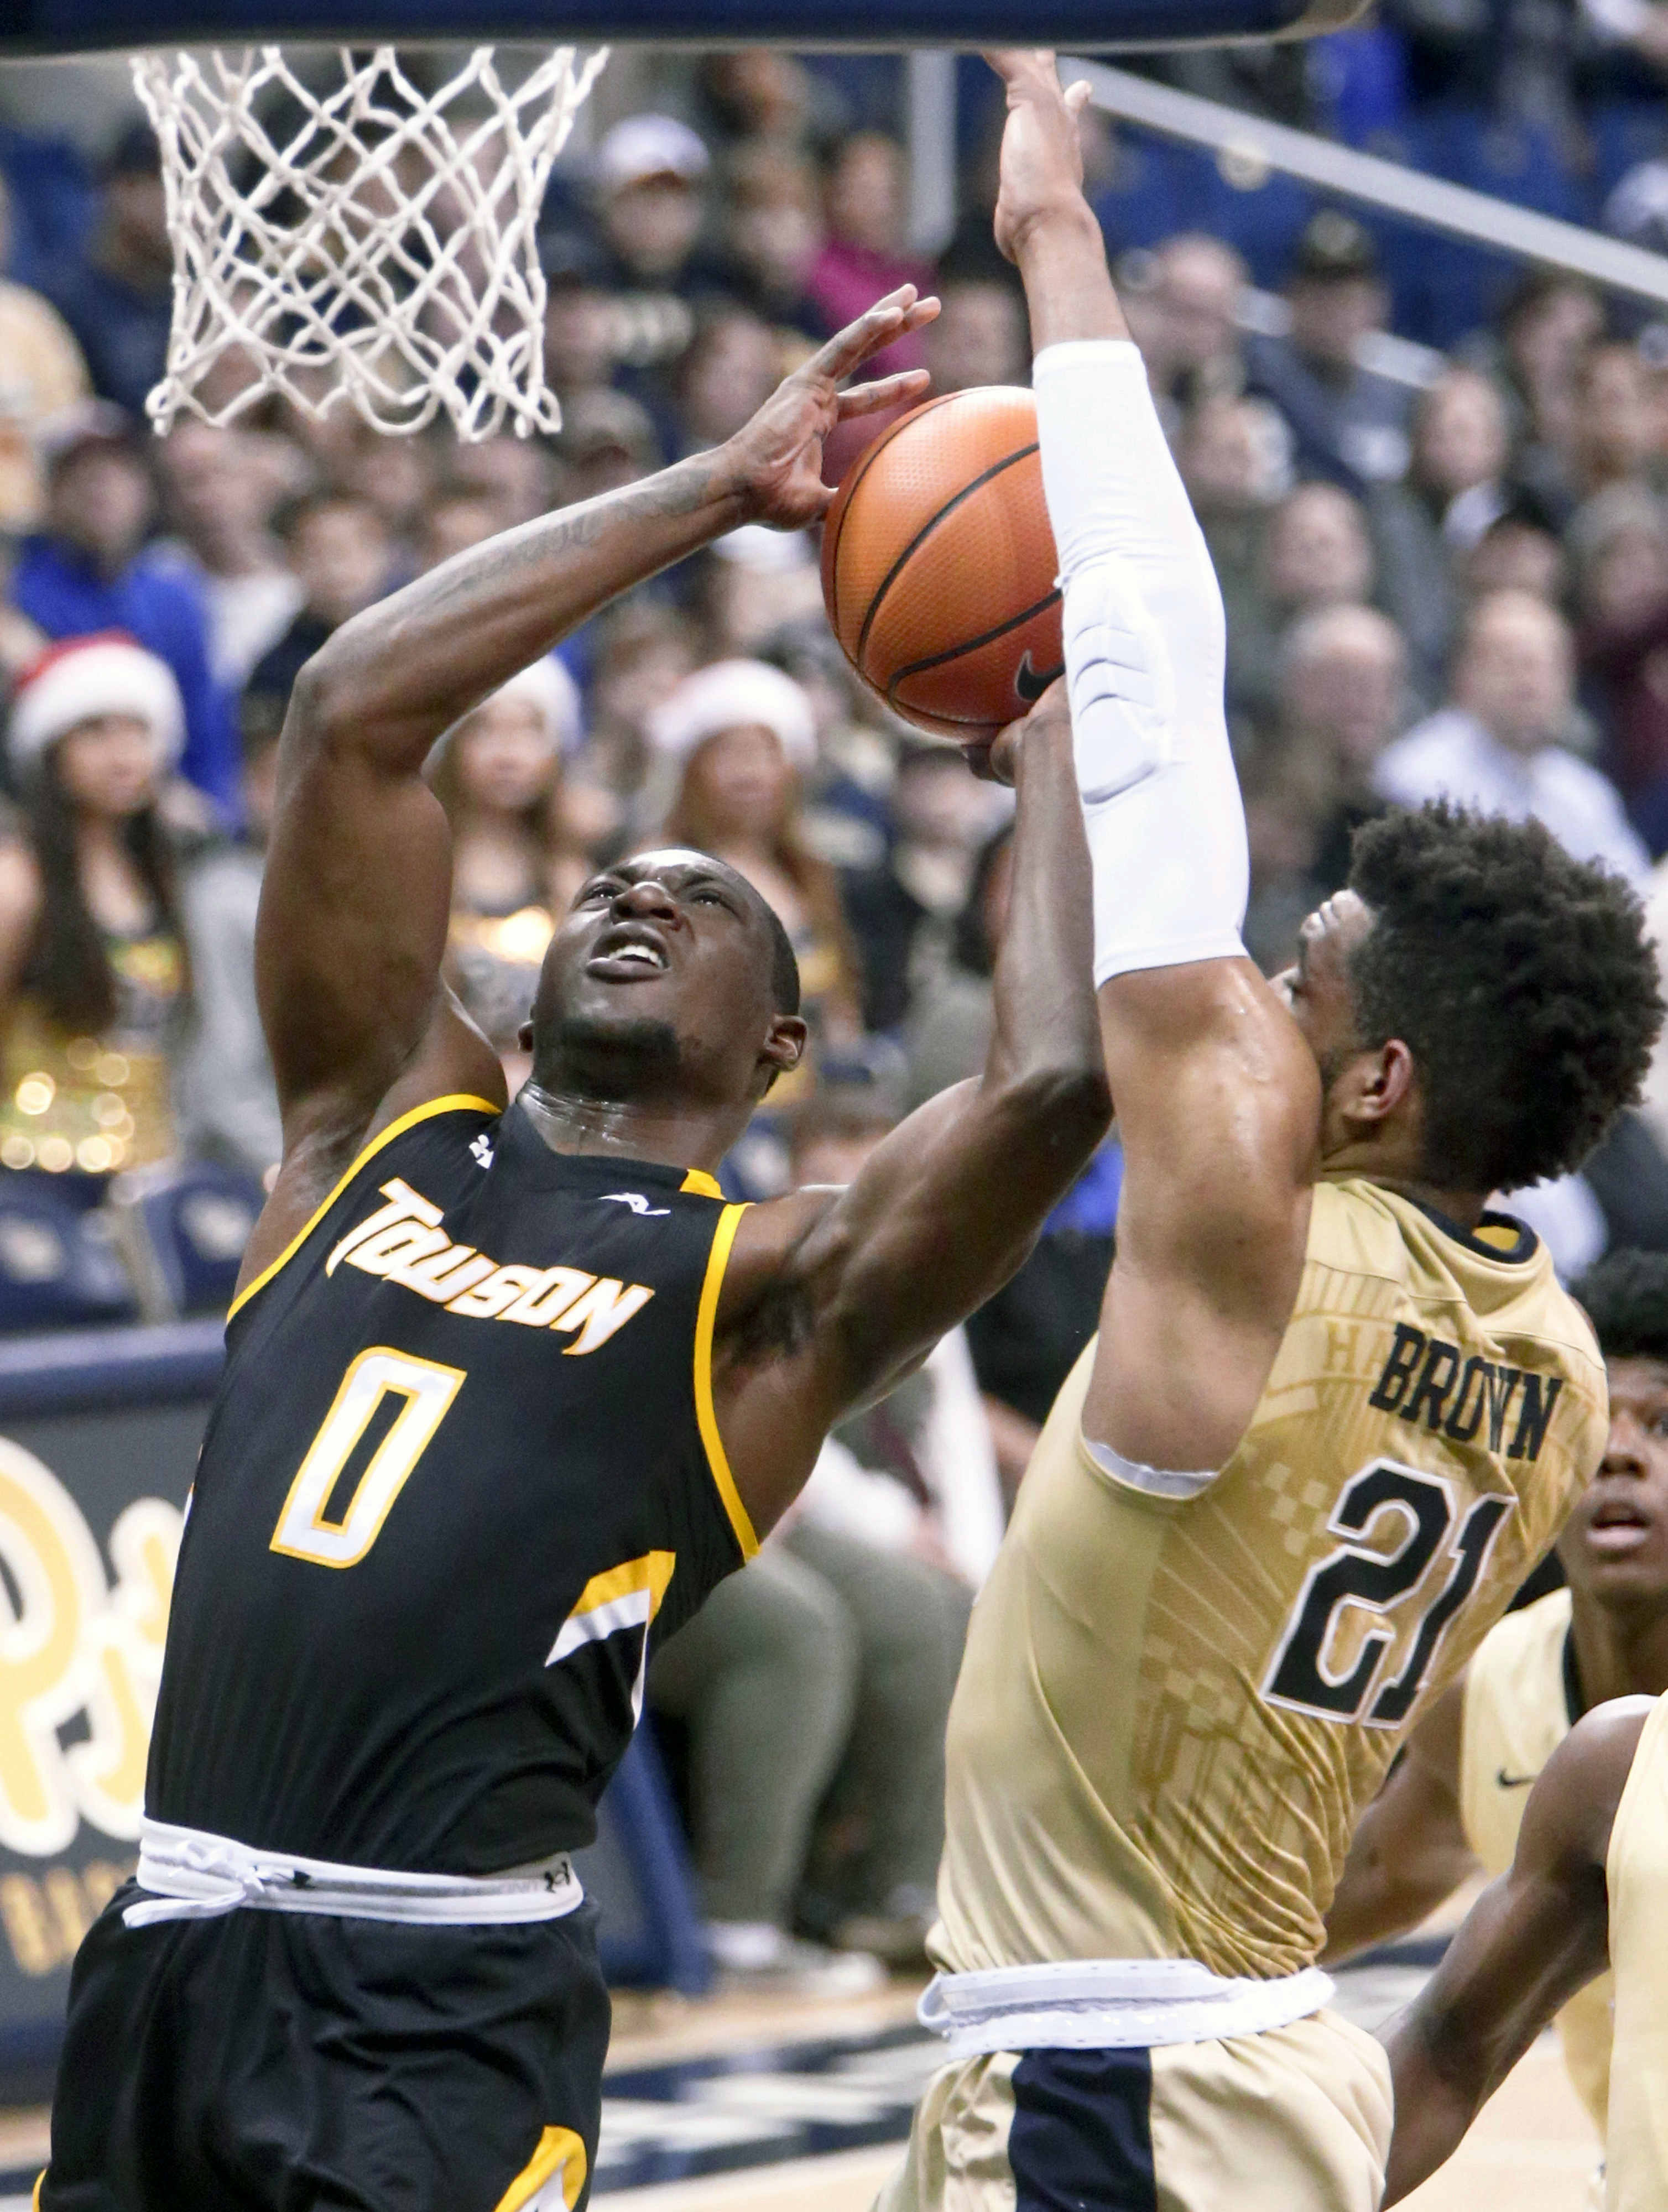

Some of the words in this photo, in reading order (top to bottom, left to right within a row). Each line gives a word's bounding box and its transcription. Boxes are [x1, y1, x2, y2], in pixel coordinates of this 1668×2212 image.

[269, 1345, 467, 1569] 0
[1368, 1321, 1563, 1461] BROWN
[1260, 1457, 1519, 1730] 21
